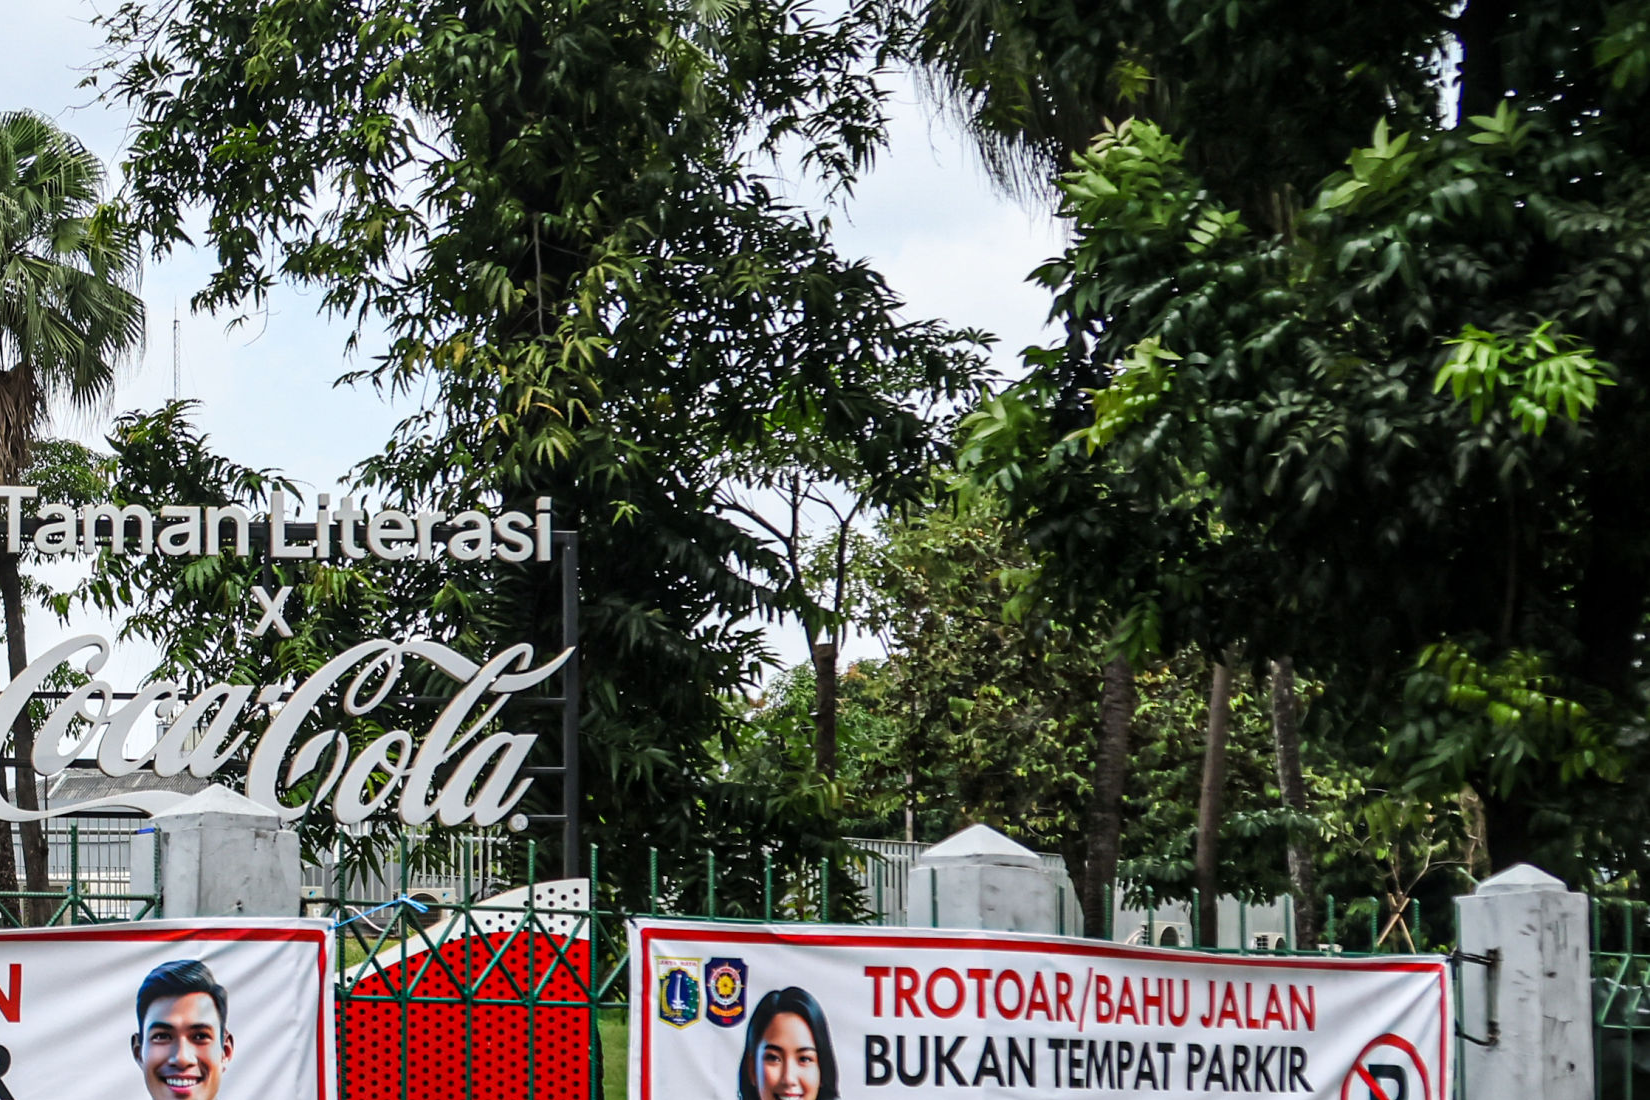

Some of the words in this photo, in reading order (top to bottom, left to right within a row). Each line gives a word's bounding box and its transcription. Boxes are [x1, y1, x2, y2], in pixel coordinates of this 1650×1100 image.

[270, 490, 552, 562] Literasi
[864, 966, 1189, 1032] TROTOAR/BAHU
[1200, 980, 1315, 1031] JALAN
[865, 1035, 1035, 1087] BUKAN
[1047, 1038, 1175, 1090] TEMPAT
[1187, 1043, 1313, 1092] PARKIR
